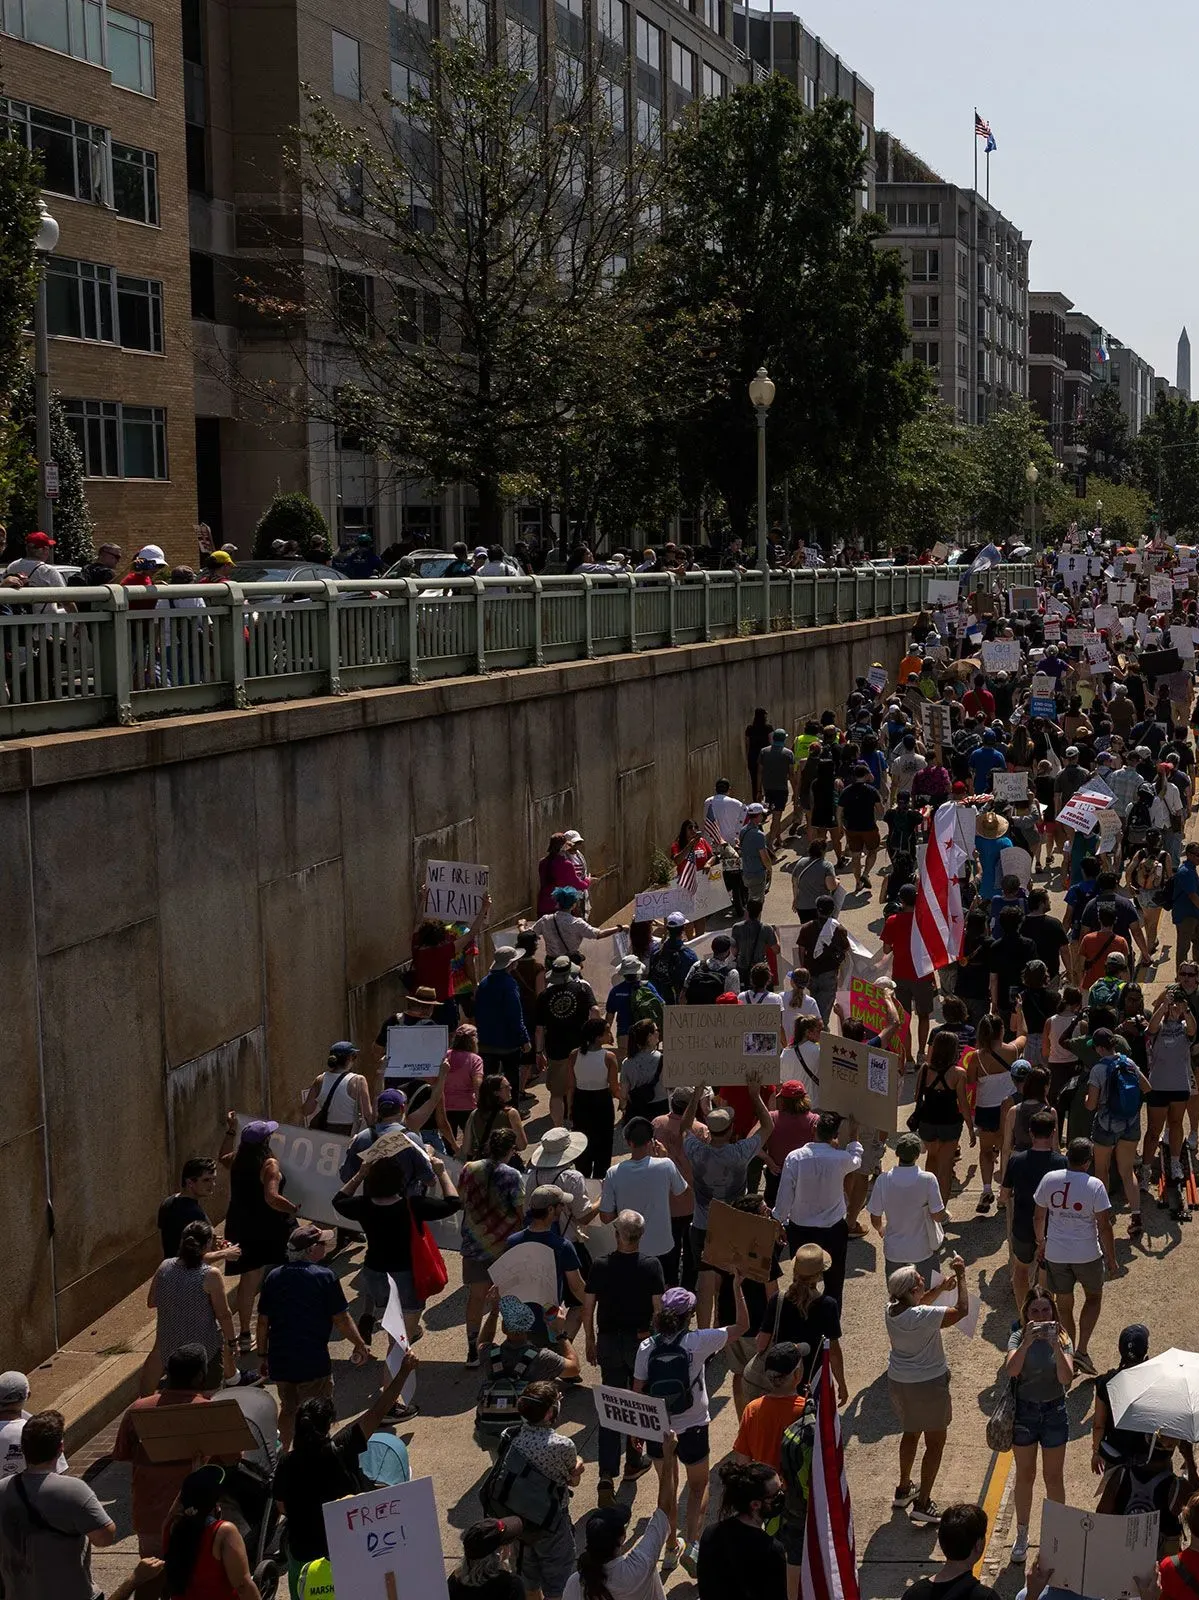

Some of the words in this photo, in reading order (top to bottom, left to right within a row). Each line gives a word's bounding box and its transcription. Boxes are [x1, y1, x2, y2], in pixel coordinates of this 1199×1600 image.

[1060, 815, 1090, 830] OCCUPATION
[1066, 812, 1089, 824] FEDERAL
[428, 866, 445, 882] WE
[452, 868, 470, 884] ARE
[475, 871, 489, 887] NOT
[425, 888, 484, 915] AFRAID
[636, 893, 669, 907] LOVE
[670, 1012, 728, 1028] NATIONAL
[668, 1036, 684, 1050] IS
[688, 1034, 711, 1048] THIS
[714, 1035, 740, 1048] WHAT
[667, 1062, 684, 1077] YOU
[688, 1061, 728, 1076] SIGNED
[601, 1394, 619, 1404] FREE
[620, 1398, 658, 1414] PALESTINE
[604, 1404, 637, 1426] FREE
[639, 1412, 661, 1431] DC
[347, 1500, 400, 1530] FREE
[367, 1526, 406, 1552] DC!
[310, 1585, 334, 1596] MARSH
